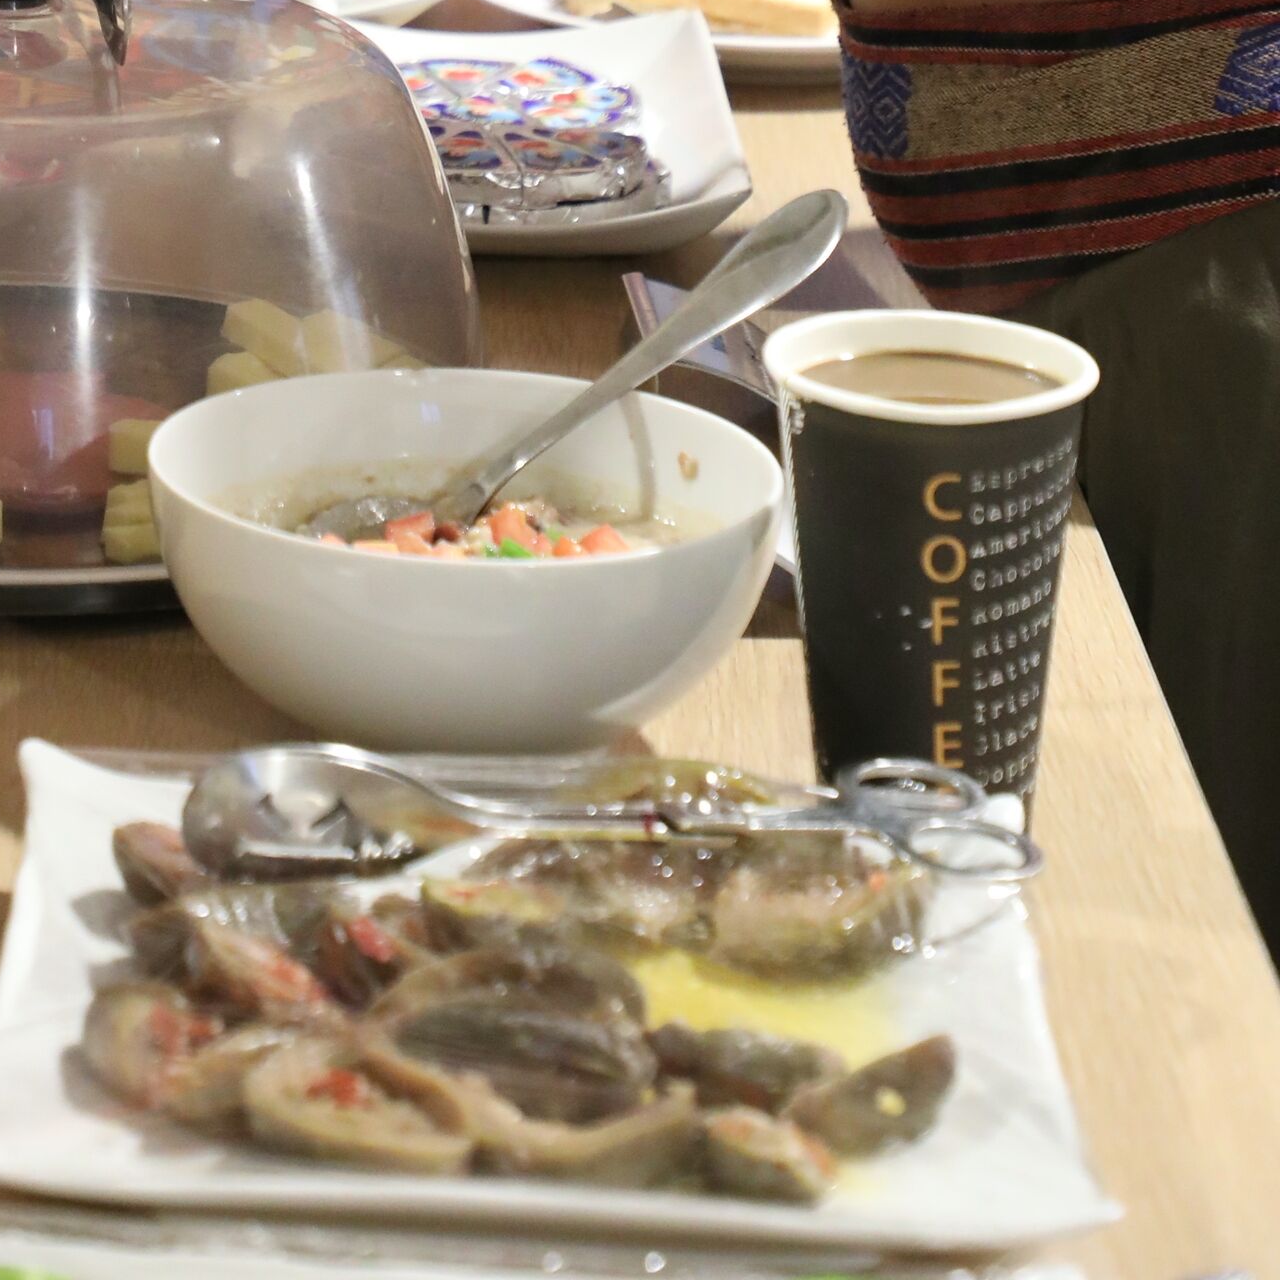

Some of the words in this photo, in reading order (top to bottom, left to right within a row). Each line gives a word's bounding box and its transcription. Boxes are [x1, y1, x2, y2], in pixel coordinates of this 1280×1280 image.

[973, 576, 1053, 626] Romano
[920, 472, 967, 790] COFFE
[973, 649, 1042, 691] Latte
[975, 682, 1040, 725] Irish
